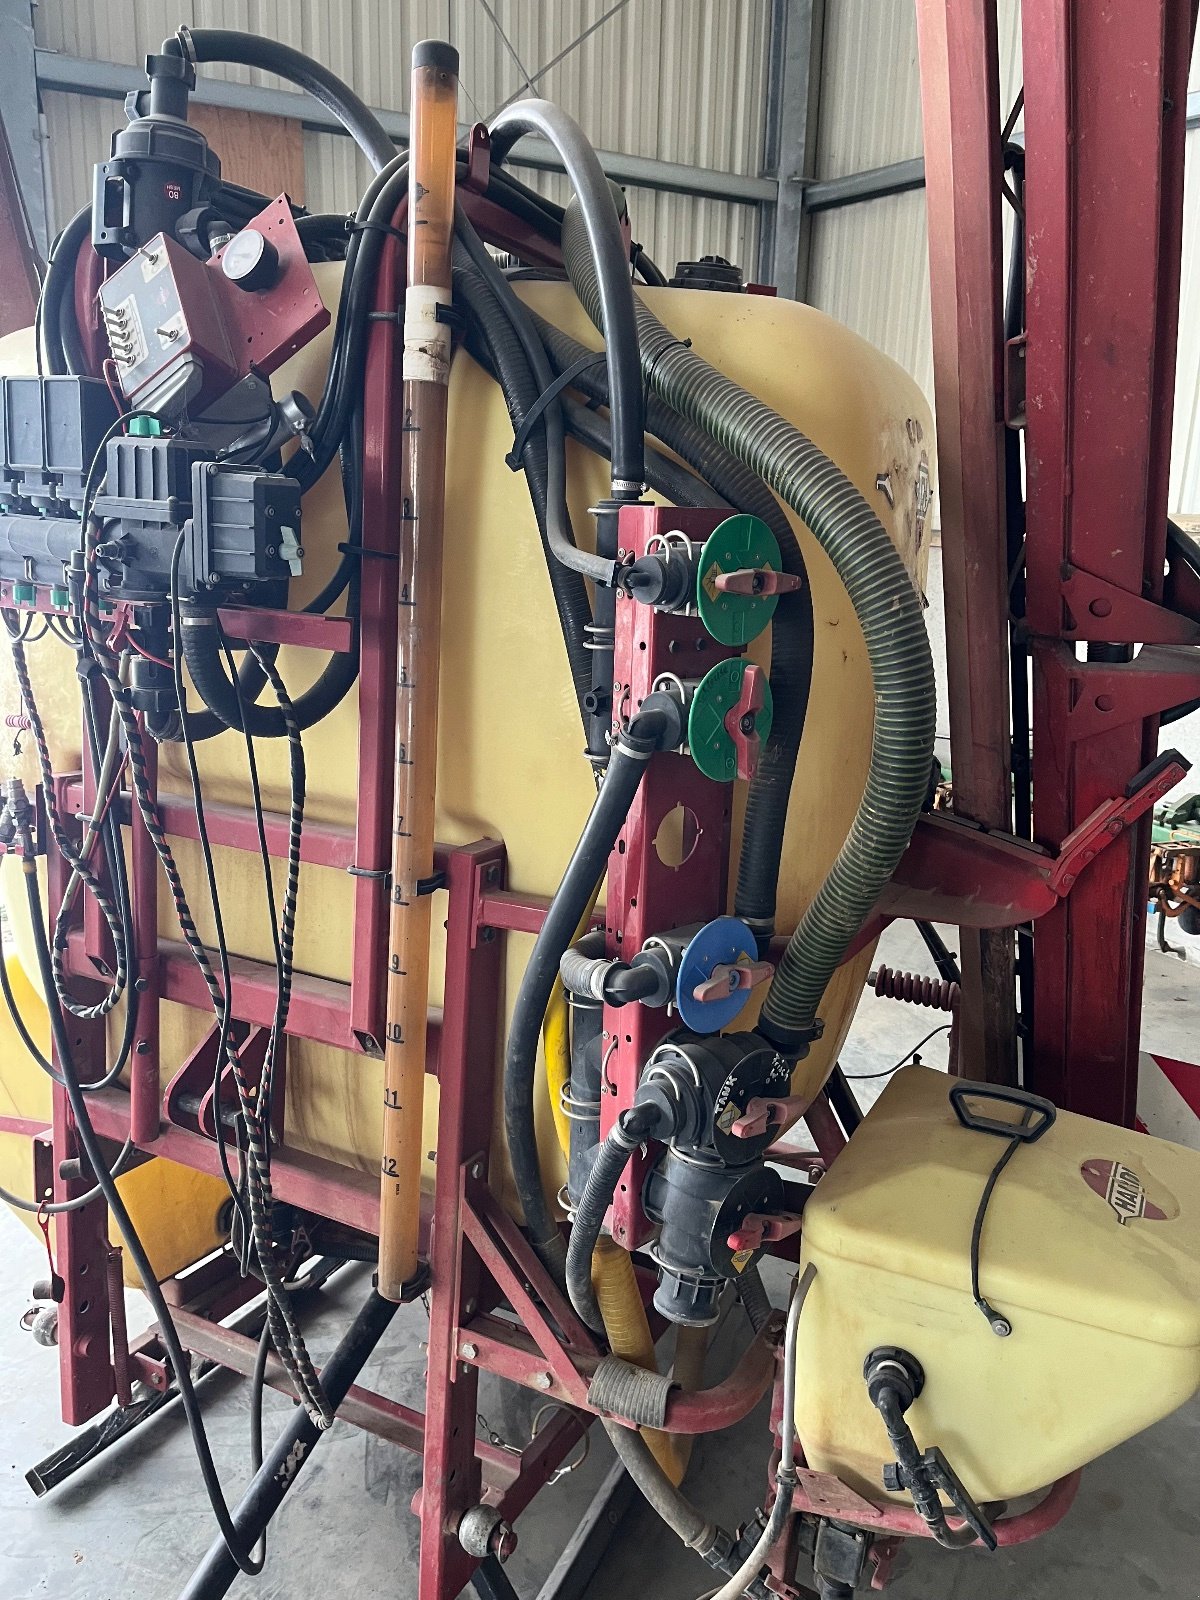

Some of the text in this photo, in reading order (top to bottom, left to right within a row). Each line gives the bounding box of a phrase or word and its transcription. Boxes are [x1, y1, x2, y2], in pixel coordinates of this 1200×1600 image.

[401, 583, 409, 601] 4
[396, 815, 404, 831] 7
[394, 885, 402, 901] 8
[391, 953, 400, 970] 9
[386, 1021, 402, 1040] 10
[385, 1087, 398, 1107] 11
[714, 1075, 738, 1114] TANK
[382, 1155, 397, 1174] 12
